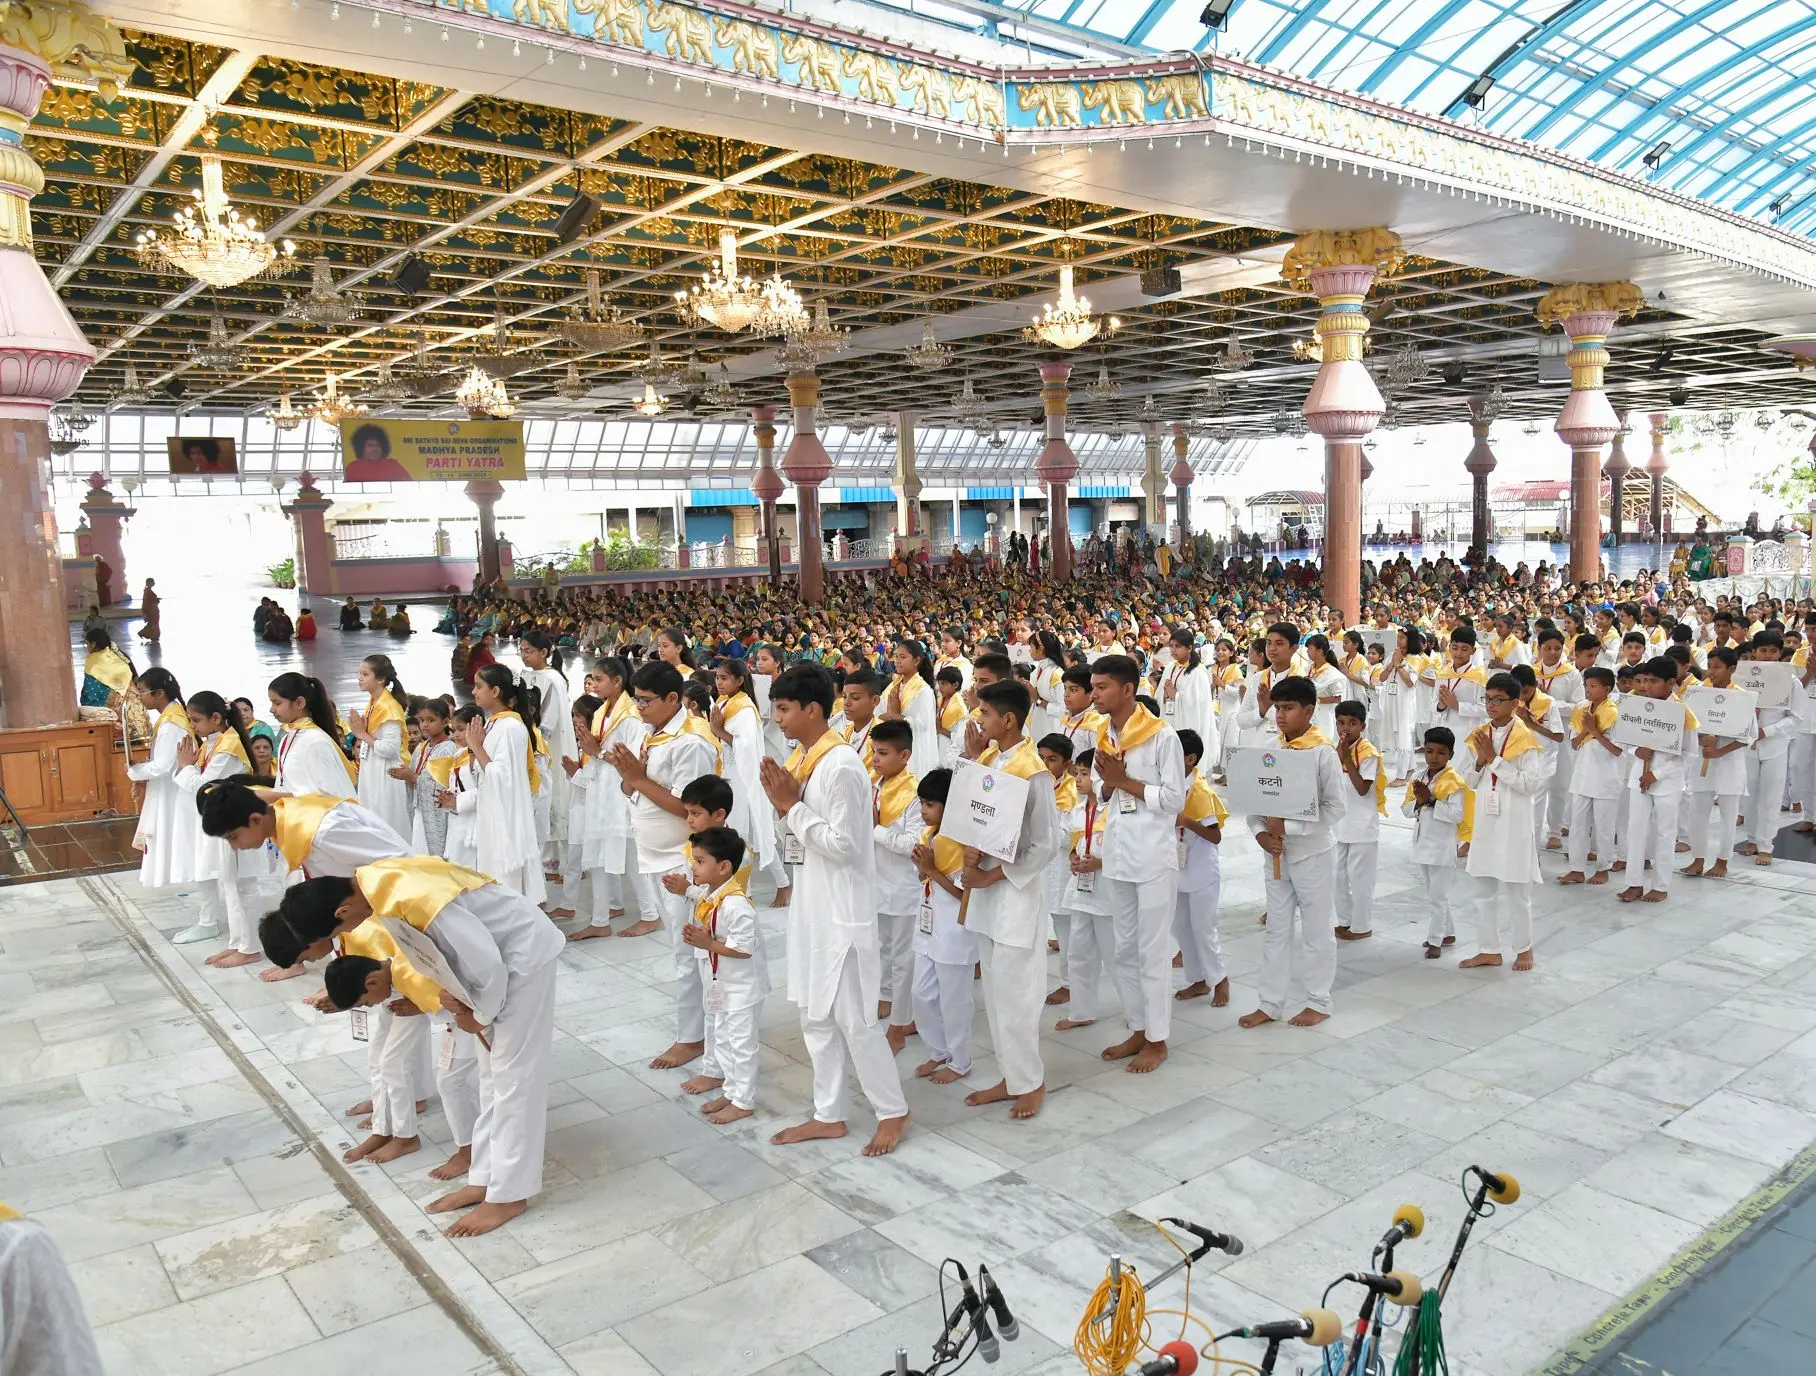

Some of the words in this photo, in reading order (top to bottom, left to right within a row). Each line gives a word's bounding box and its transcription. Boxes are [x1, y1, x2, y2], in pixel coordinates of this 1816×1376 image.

[418, 446, 457, 455] MADHYA
[459, 446, 500, 455] PRADESH
[426, 458, 462, 468] PARTI
[467, 458, 505, 468] YATRA
[1258, 775, 1283, 788] कटनी
[970, 799, 996, 817] मण्डला
